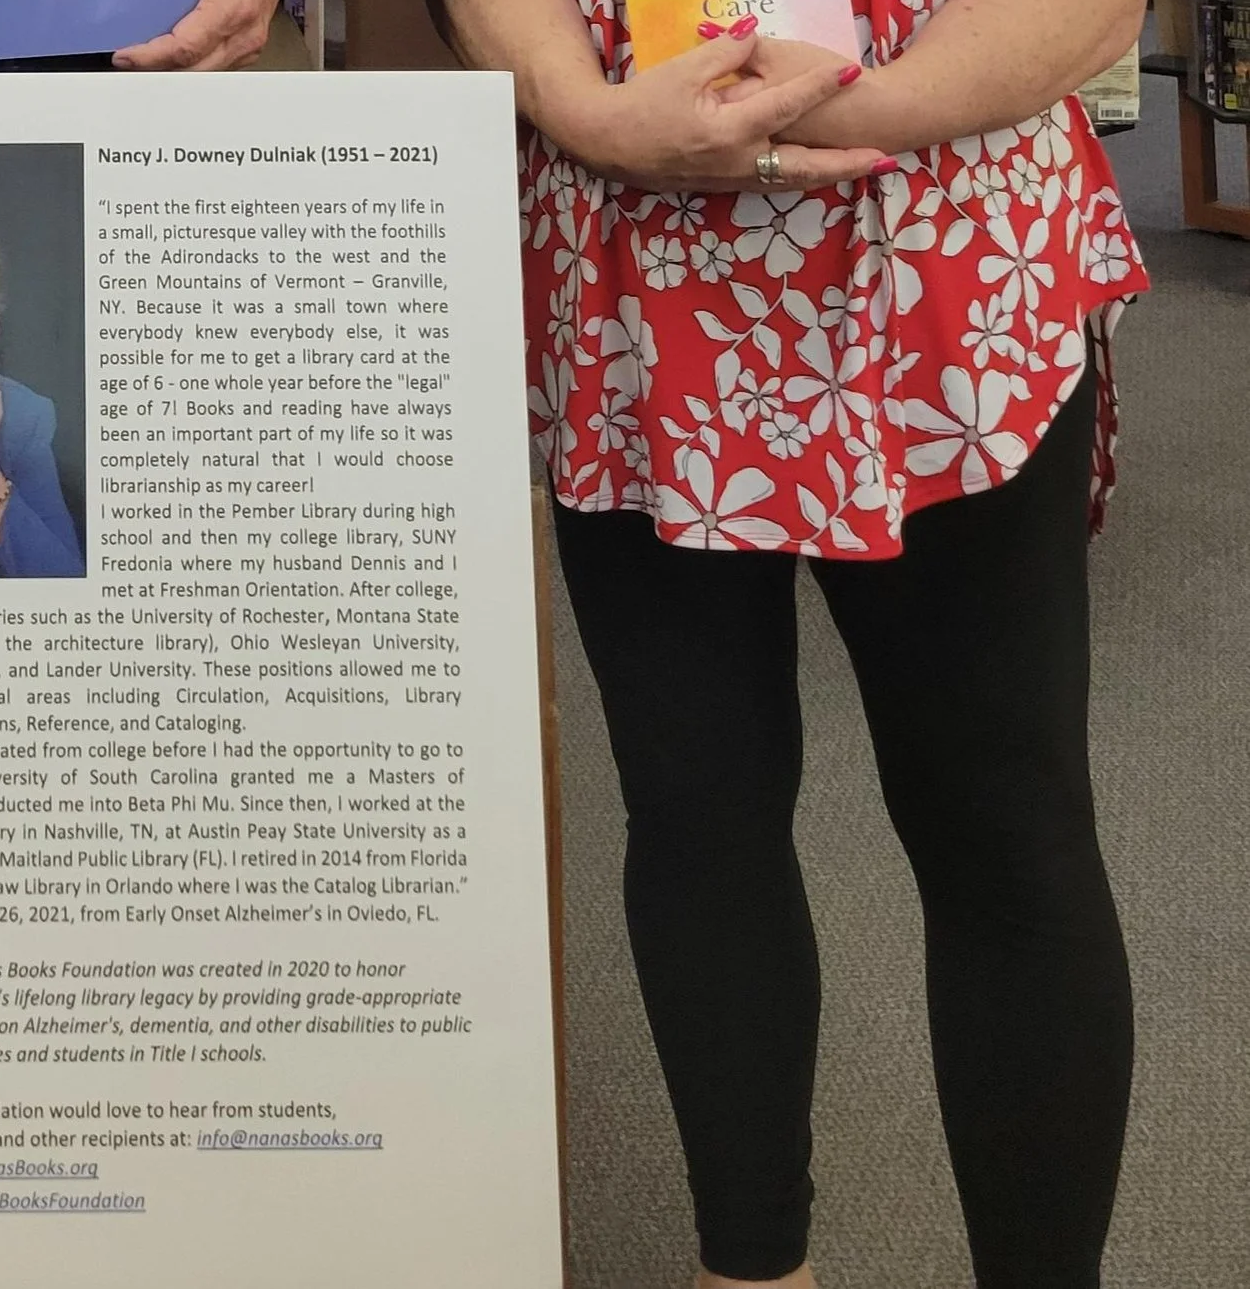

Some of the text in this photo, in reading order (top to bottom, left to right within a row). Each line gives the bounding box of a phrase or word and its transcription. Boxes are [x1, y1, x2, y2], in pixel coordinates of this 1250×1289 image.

[98, 147, 152, 167] Nancy
[155, 147, 169, 163] J.
[174, 147, 245, 167] Downey
[250, 145, 317, 163] Dulniak
[321, 145, 370, 166] (1951
[389, 145, 438, 166] 2021)
[98, 198, 445, 219] “I spent the first eighteen years of my life in
[30, 1129, 77, 1148] other
[81, 1129, 165, 1151] recipients
[169, 1131, 192, 1147] at:
[197, 1129, 383, 1151] info@nanasbooks.org
